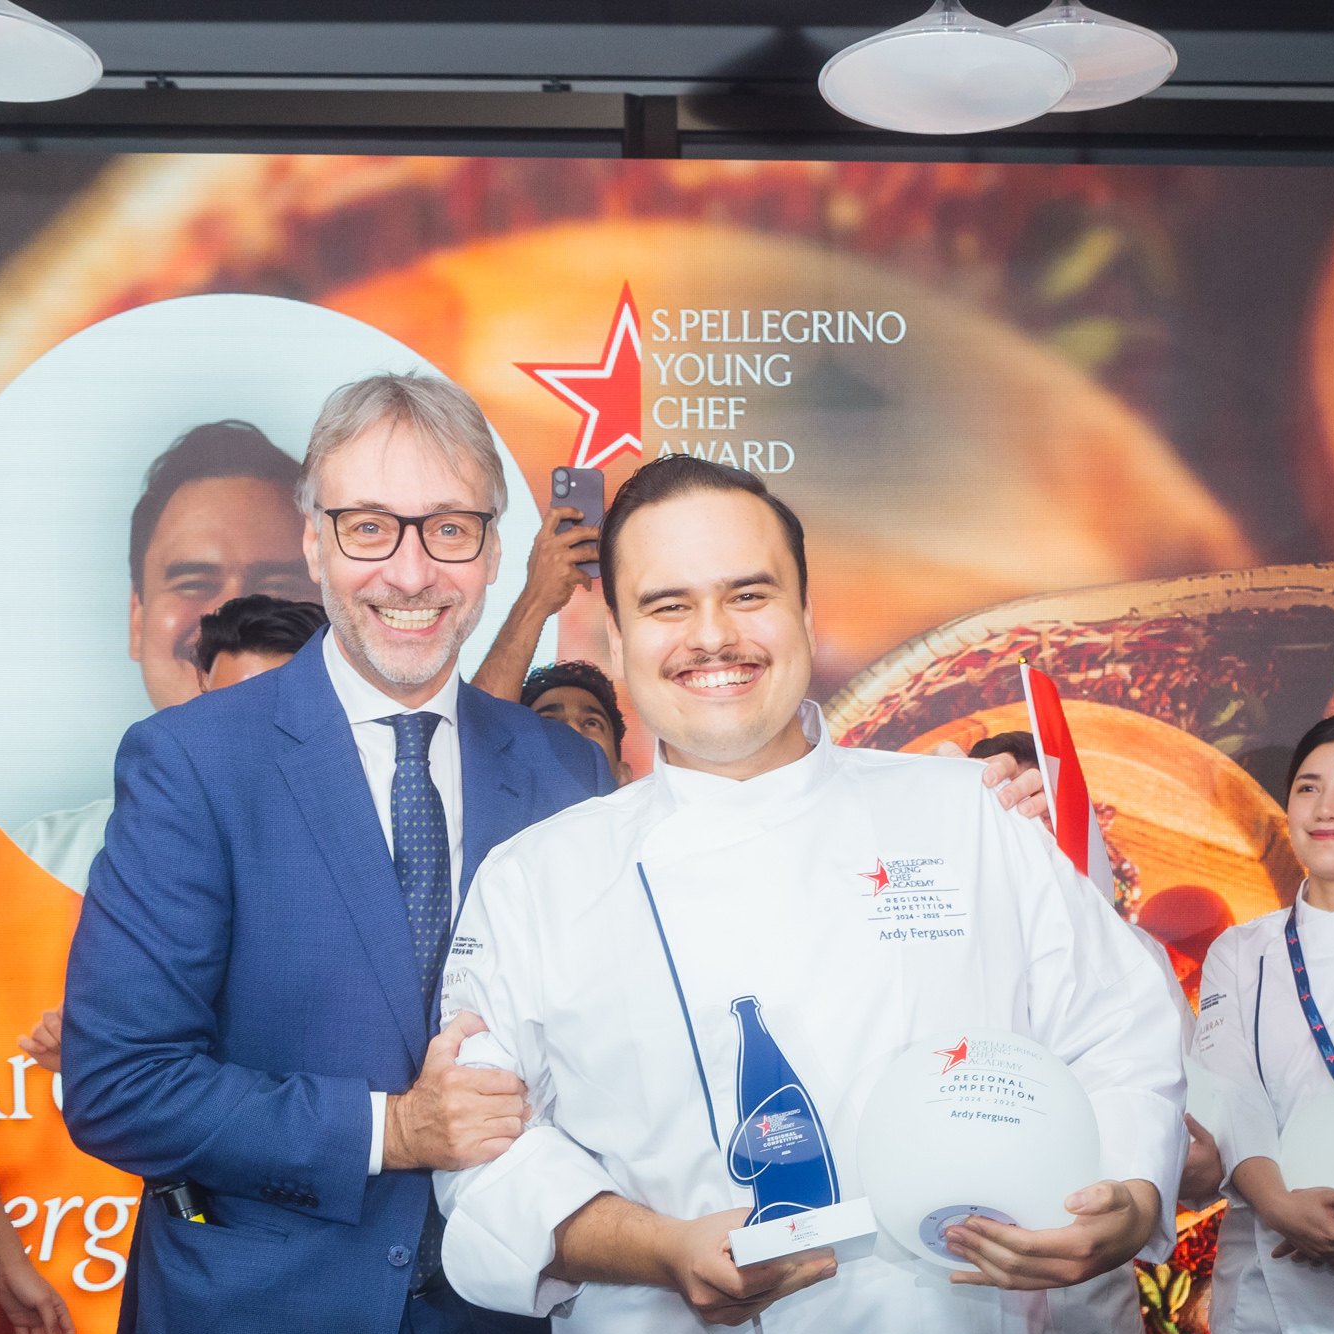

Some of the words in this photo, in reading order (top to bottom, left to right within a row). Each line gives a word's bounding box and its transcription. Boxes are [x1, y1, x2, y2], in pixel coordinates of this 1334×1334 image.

[651, 308, 907, 344] S.PELLEGRINO
[651, 352, 793, 387] YOUNG
[652, 395, 747, 430] CHEF
[888, 866, 922, 875] YOUNG
[890, 873, 912, 882] CHEF
[892, 879, 935, 888] ACADEMY
[885, 895, 942, 904] REGIONAL
[877, 903, 953, 913] COMPETITION
[896, 912, 915, 920] 2024
[879, 928, 907, 942] Ardy
[910, 927, 966, 941] Ferguson
[968, 1058, 1023, 1071] ACADEMY
[954, 1074, 1024, 1089] REGIONAL
[939, 1084, 1035, 1102] COMPETITION
[951, 1110, 973, 1120] Ardy
[976, 1112, 1021, 1125] Ferguson
[762, 1133, 803, 1148] COMPETITION
[767, 1131, 797, 1142] REGIONAL
